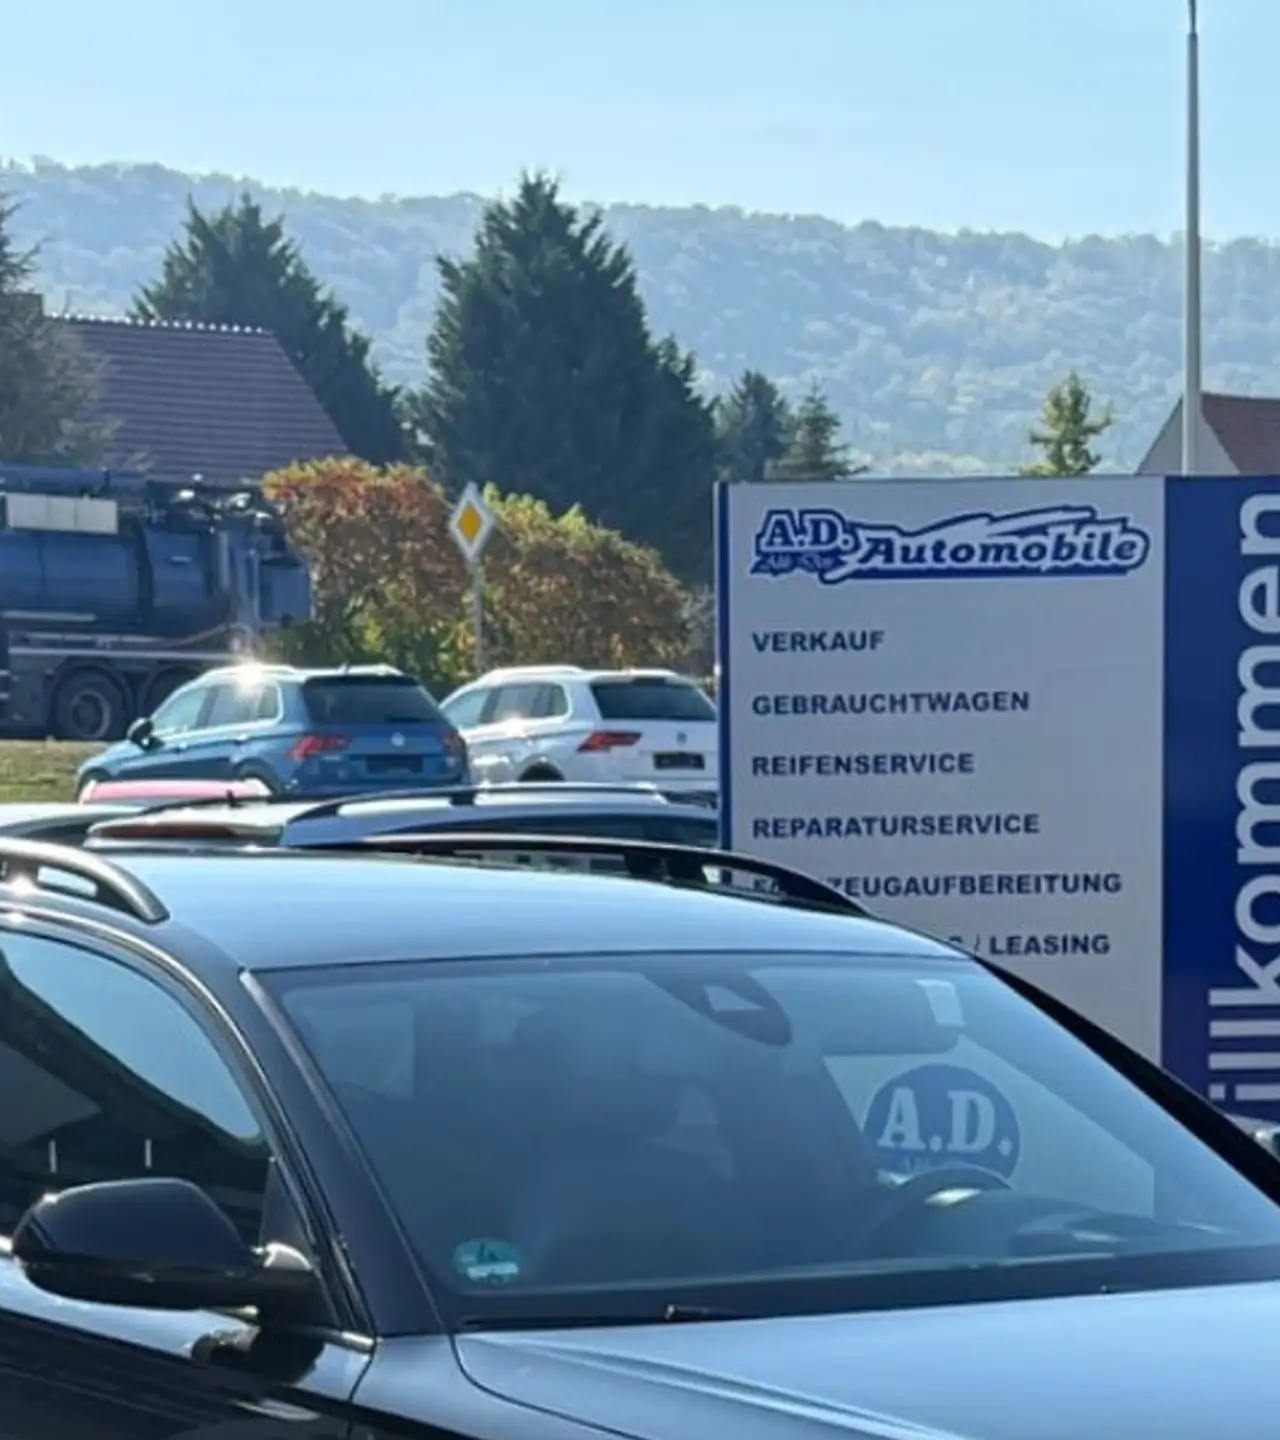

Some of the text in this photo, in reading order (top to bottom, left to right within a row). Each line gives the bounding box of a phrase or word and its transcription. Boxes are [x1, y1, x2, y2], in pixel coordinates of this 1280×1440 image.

[765, 516, 851, 549] A.D.
[859, 529, 1138, 565] Automobile
[752, 630, 885, 654] VERKAUF
[752, 691, 1031, 717] GEBRAUCHTWAGEN
[752, 753, 975, 777] REIFENSERVICE
[752, 813, 1042, 840] REPARATURSERVICE
[989, 933, 1111, 956] LEASING
[876, 1086, 1013, 1156] A.D.
